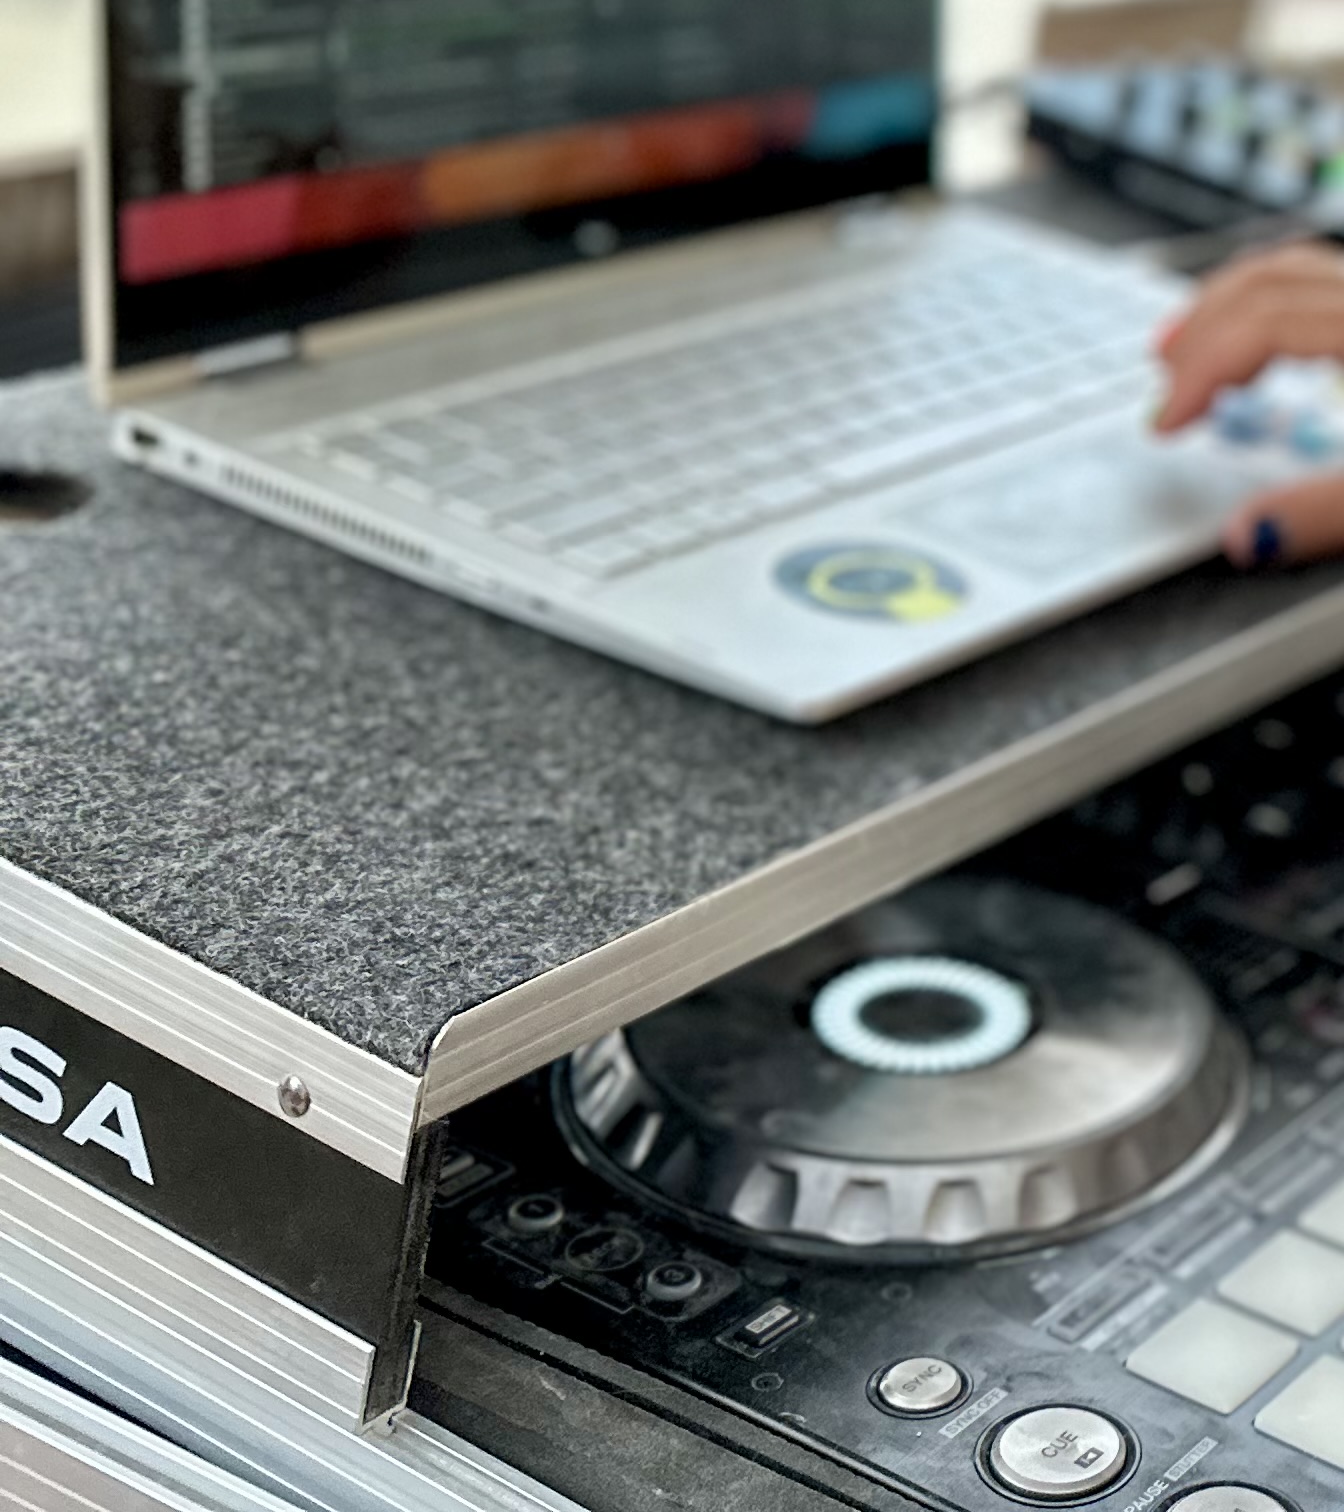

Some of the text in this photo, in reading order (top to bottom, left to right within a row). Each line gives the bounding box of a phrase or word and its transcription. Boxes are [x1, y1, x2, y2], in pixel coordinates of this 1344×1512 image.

[0, 1026, 156, 1186] SA
[902, 1364, 943, 1393] SYNC
[945, 1392, 1003, 1435] SYNC OFF
[1041, 1430, 1078, 1458] CUE
